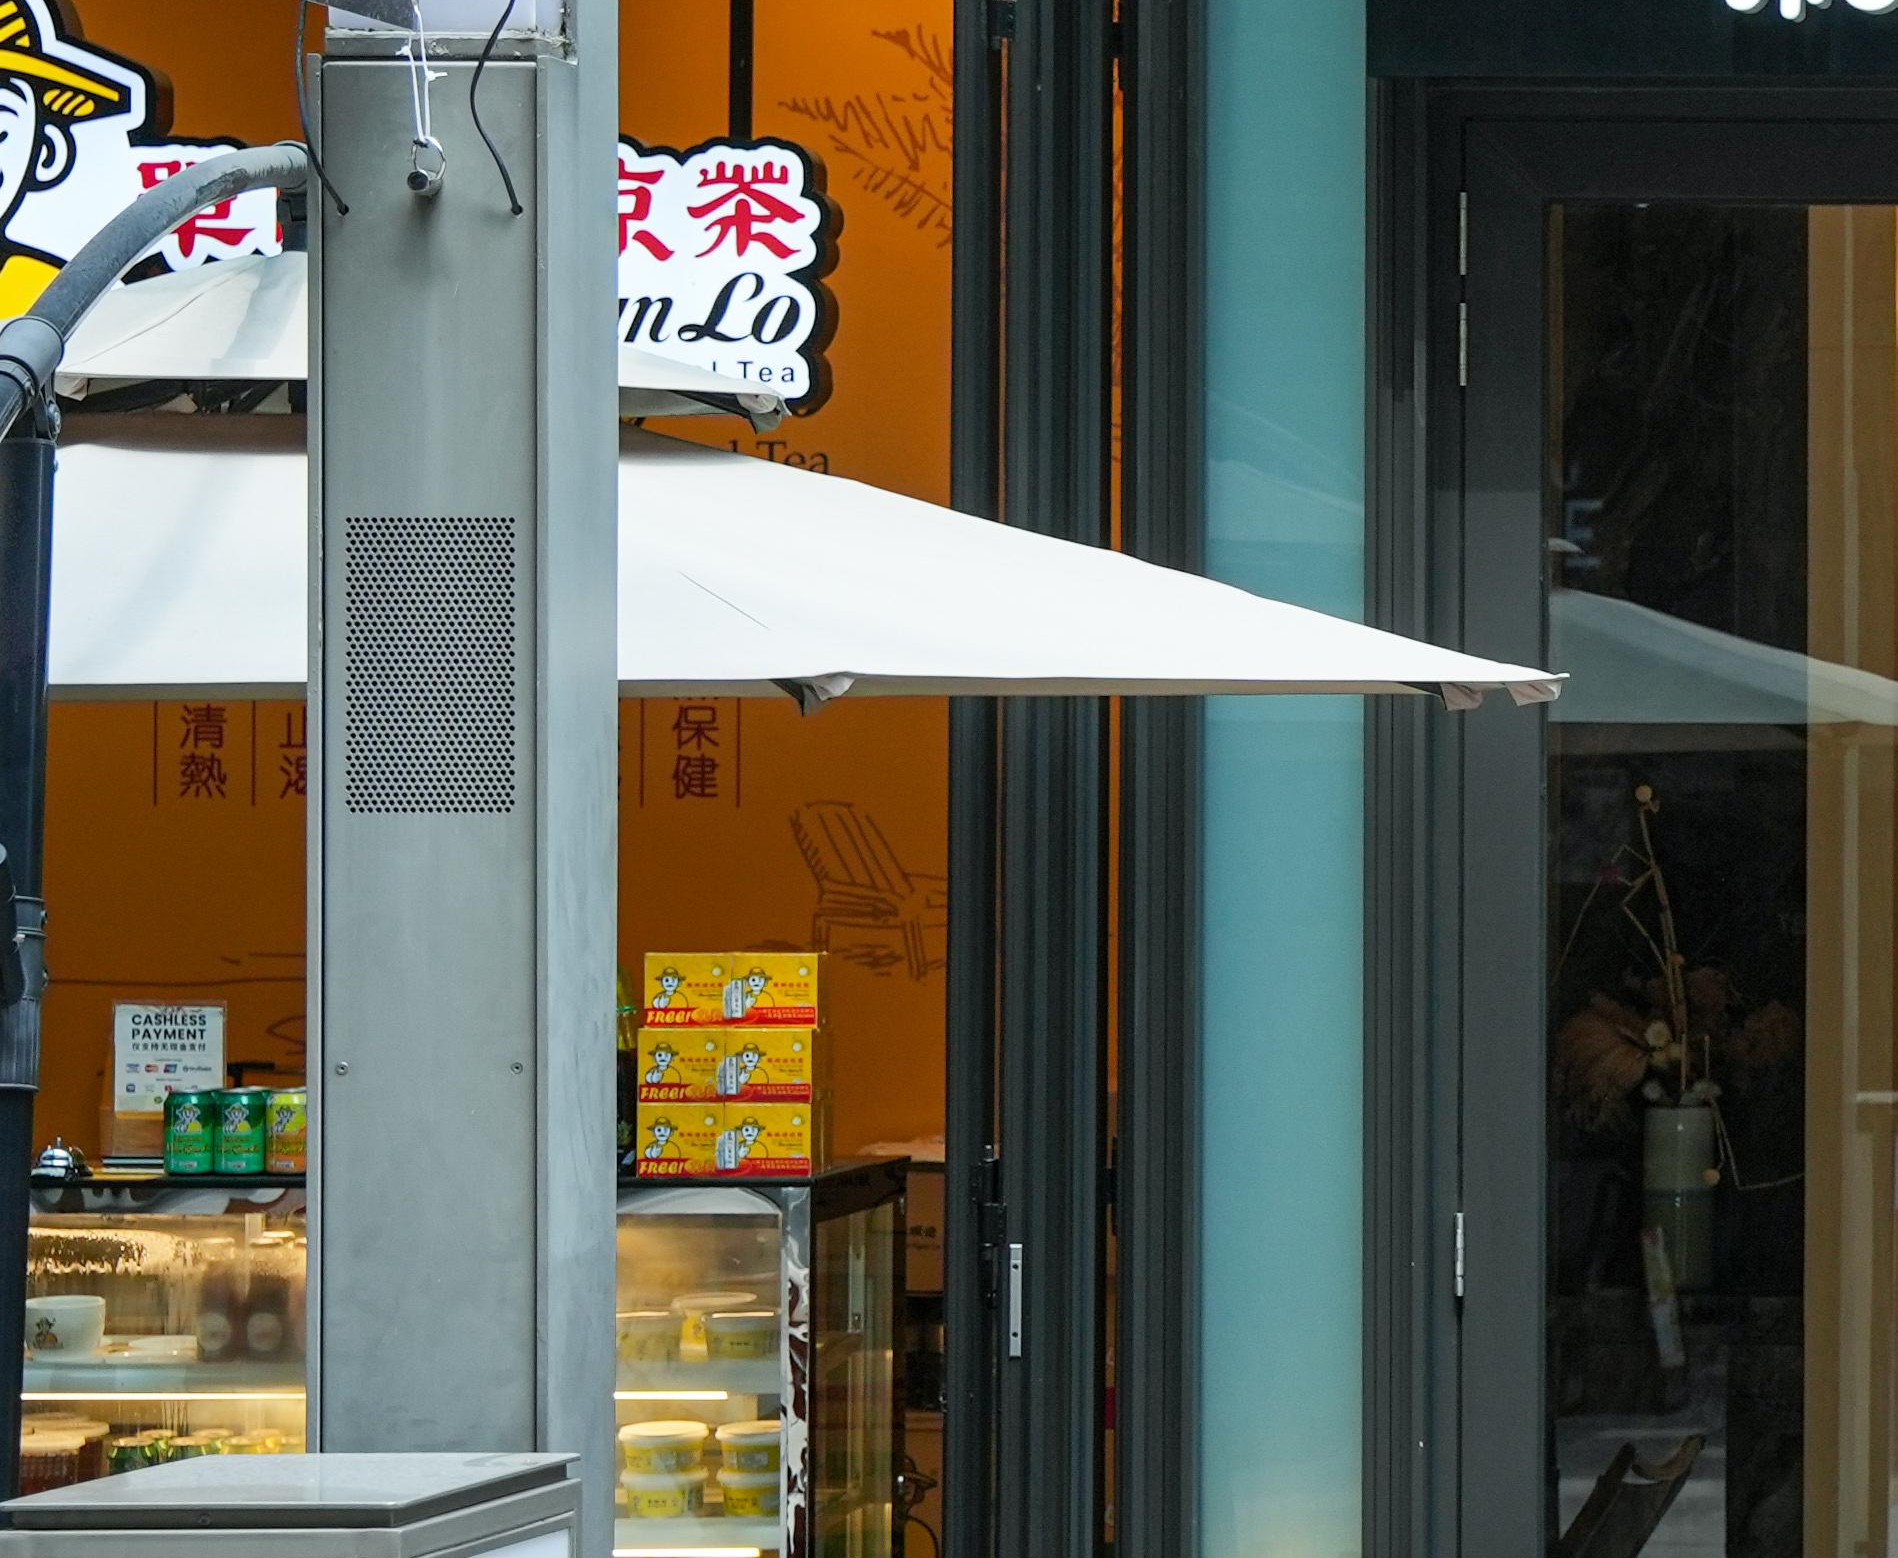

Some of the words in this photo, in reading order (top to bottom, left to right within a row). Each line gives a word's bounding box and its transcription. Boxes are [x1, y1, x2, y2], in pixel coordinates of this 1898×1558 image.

[737, 360, 795, 383] Tea
[672, 698, 720, 800] 保健
[131, 1014, 207, 1026] CASHLESS
[131, 1028, 207, 1040] PAYMENT
